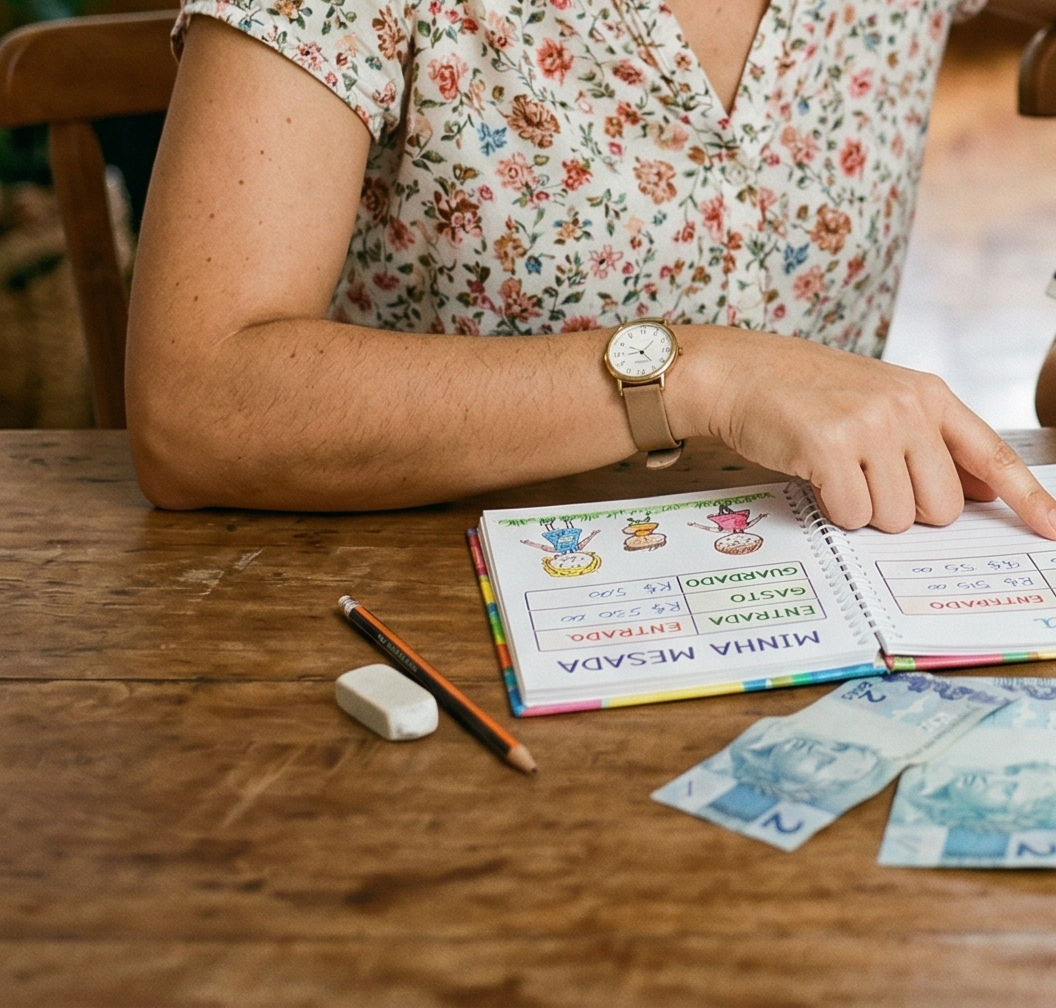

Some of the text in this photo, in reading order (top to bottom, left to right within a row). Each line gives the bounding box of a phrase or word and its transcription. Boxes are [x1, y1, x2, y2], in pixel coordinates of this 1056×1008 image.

[685, 566, 799, 588] GUARDADO
[729, 586, 807, 603] GASTO
[570, 605, 816, 643] ENTRADA ENTRADO
[555, 630, 821, 675] MINHA MESADA
[857, 680, 886, 704] 2
[763, 812, 805, 836] 2
